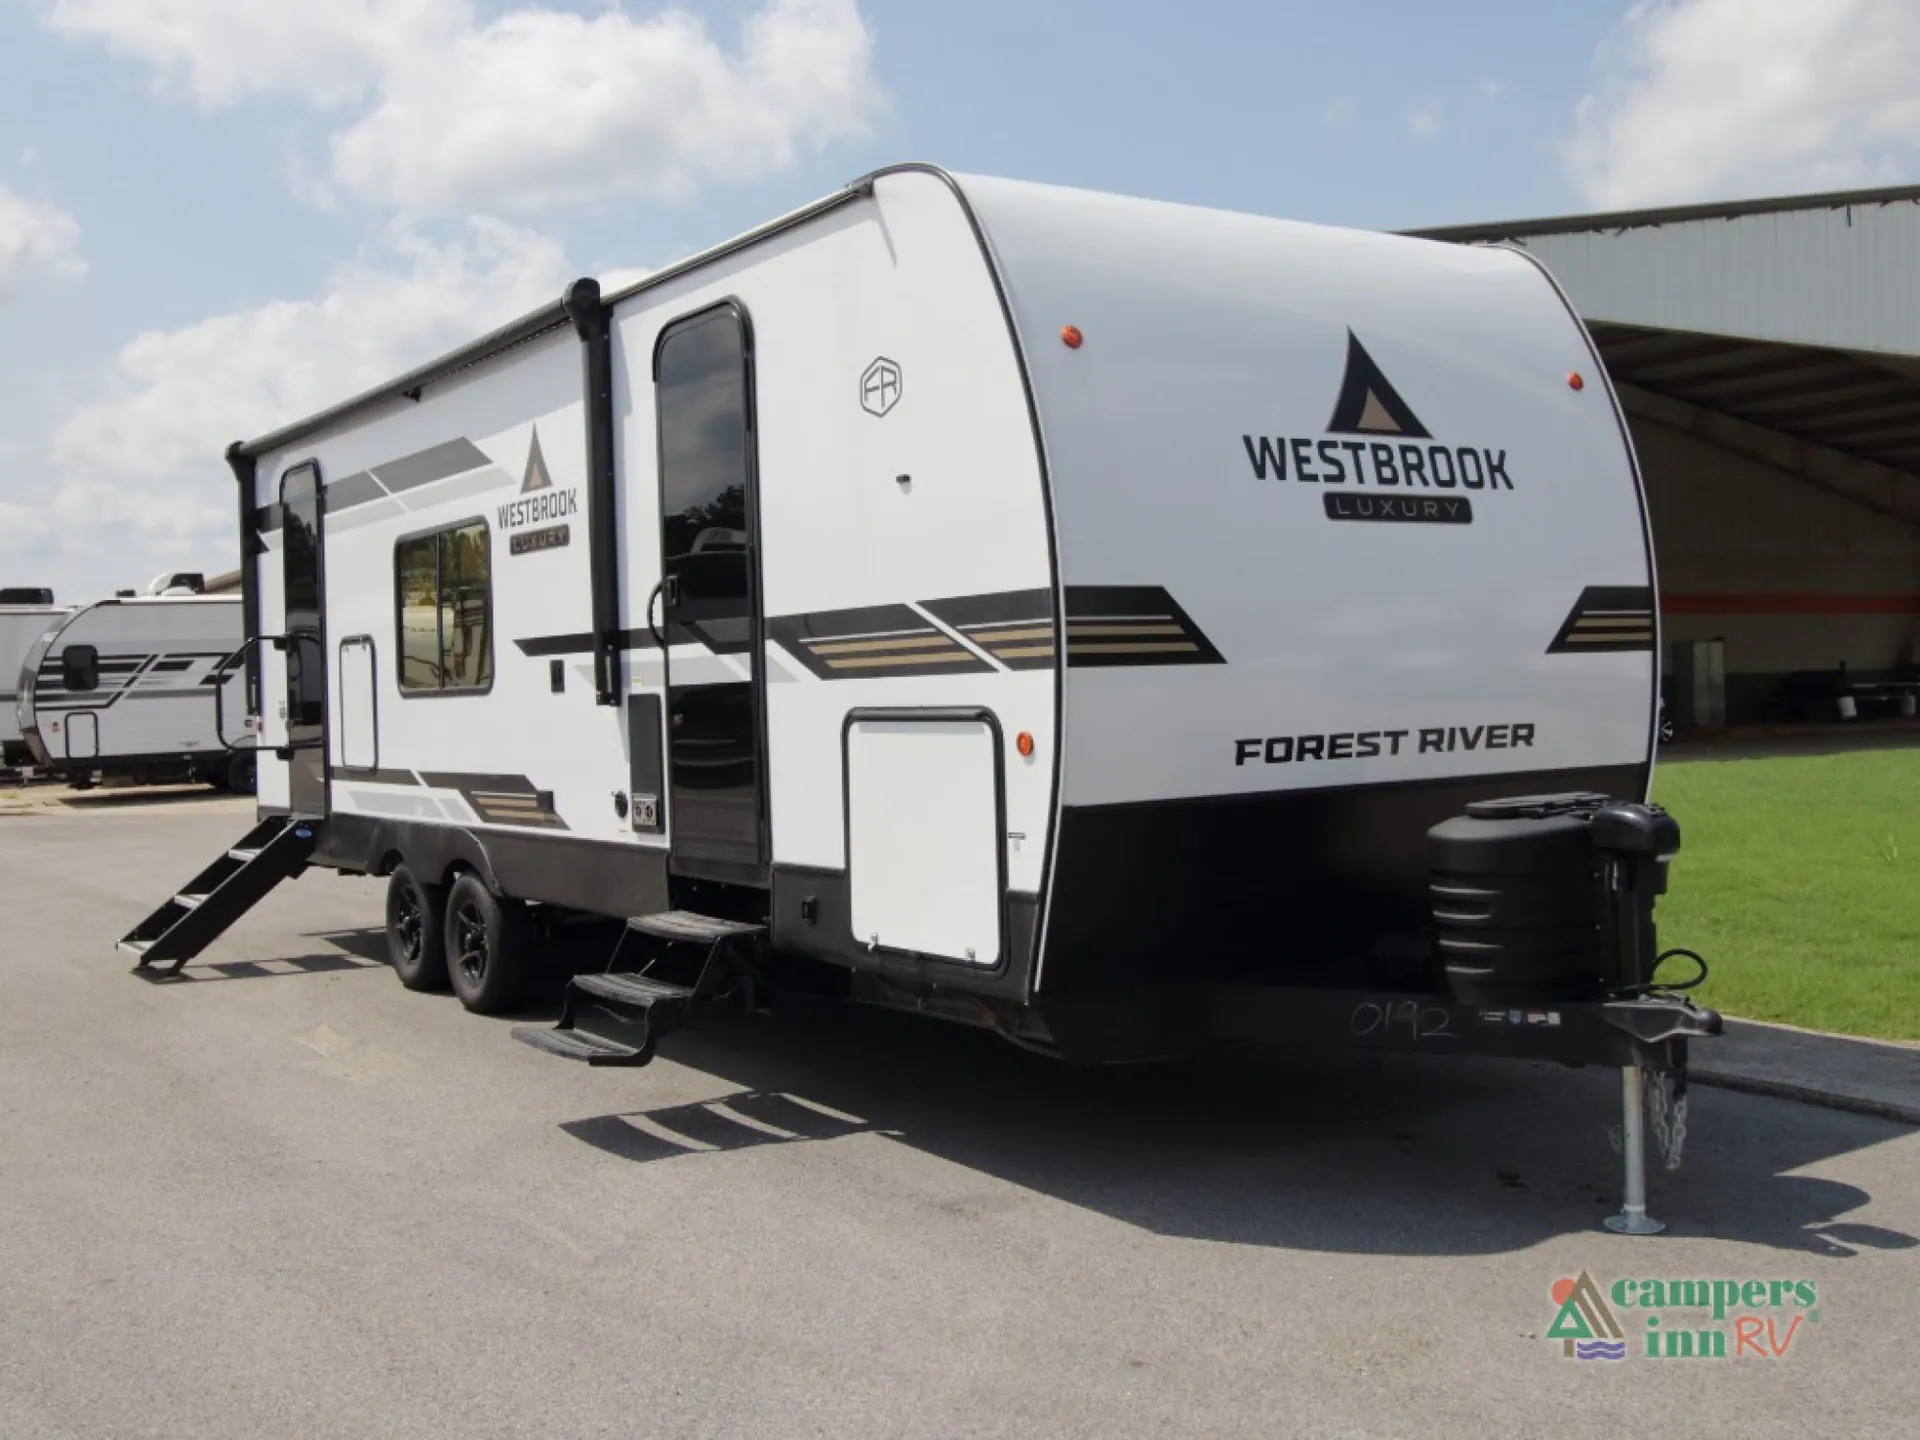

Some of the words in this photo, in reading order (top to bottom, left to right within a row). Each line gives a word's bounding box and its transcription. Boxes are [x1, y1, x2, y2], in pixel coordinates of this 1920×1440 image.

[1242, 434, 1514, 490] WESTBROOK
[497, 487, 577, 530] WESTBROOK
[1336, 497, 1460, 518] LUXURY
[512, 529, 567, 553] LUXURY
[1233, 730, 1409, 766] FOREST
[1418, 723, 1535, 754] RIVER
[1350, 1000, 1459, 1044] 0192
